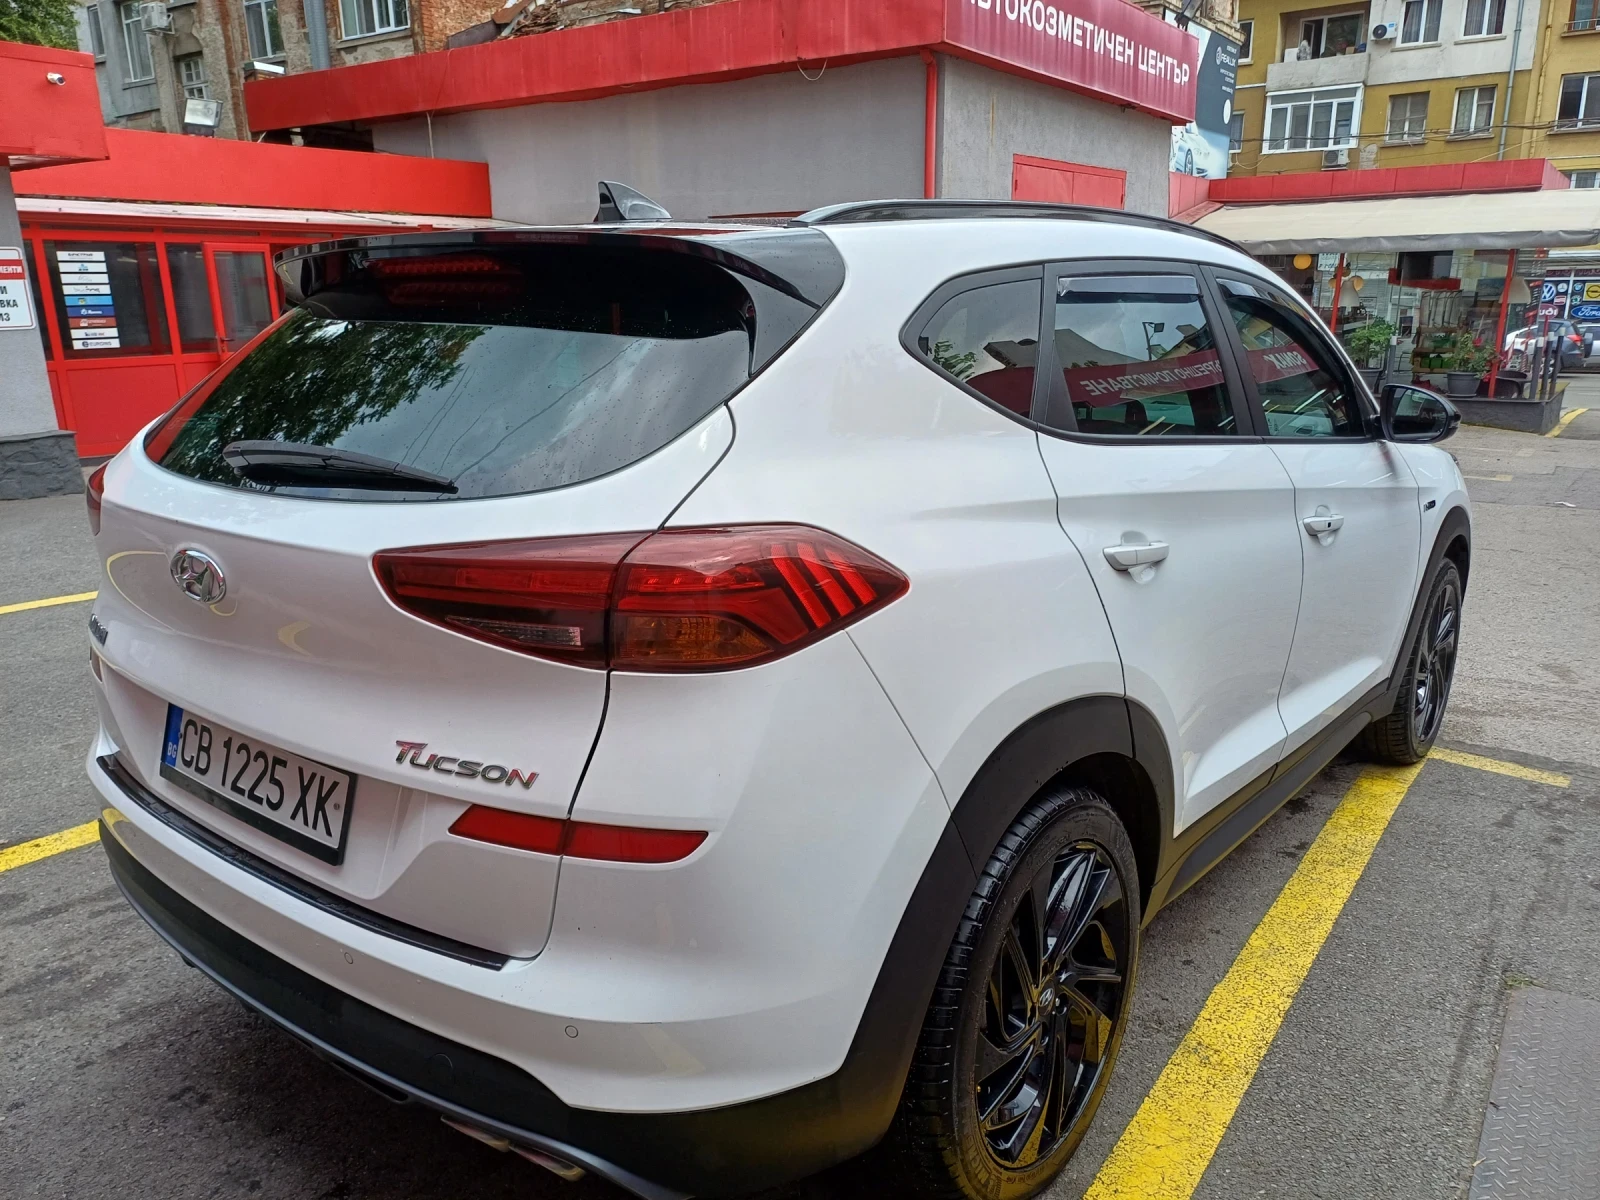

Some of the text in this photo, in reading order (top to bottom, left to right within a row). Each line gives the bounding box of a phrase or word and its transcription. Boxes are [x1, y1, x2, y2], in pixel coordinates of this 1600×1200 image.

[970, 0, 1190, 86] ОКОЗМЕТИЧЕН ЦЕНТЪР
[1539, 307, 1558, 316] udi
[167, 742, 178, 759] BG
[395, 740, 540, 789] TUCSON
[180, 718, 340, 837] CB 1225 XK
